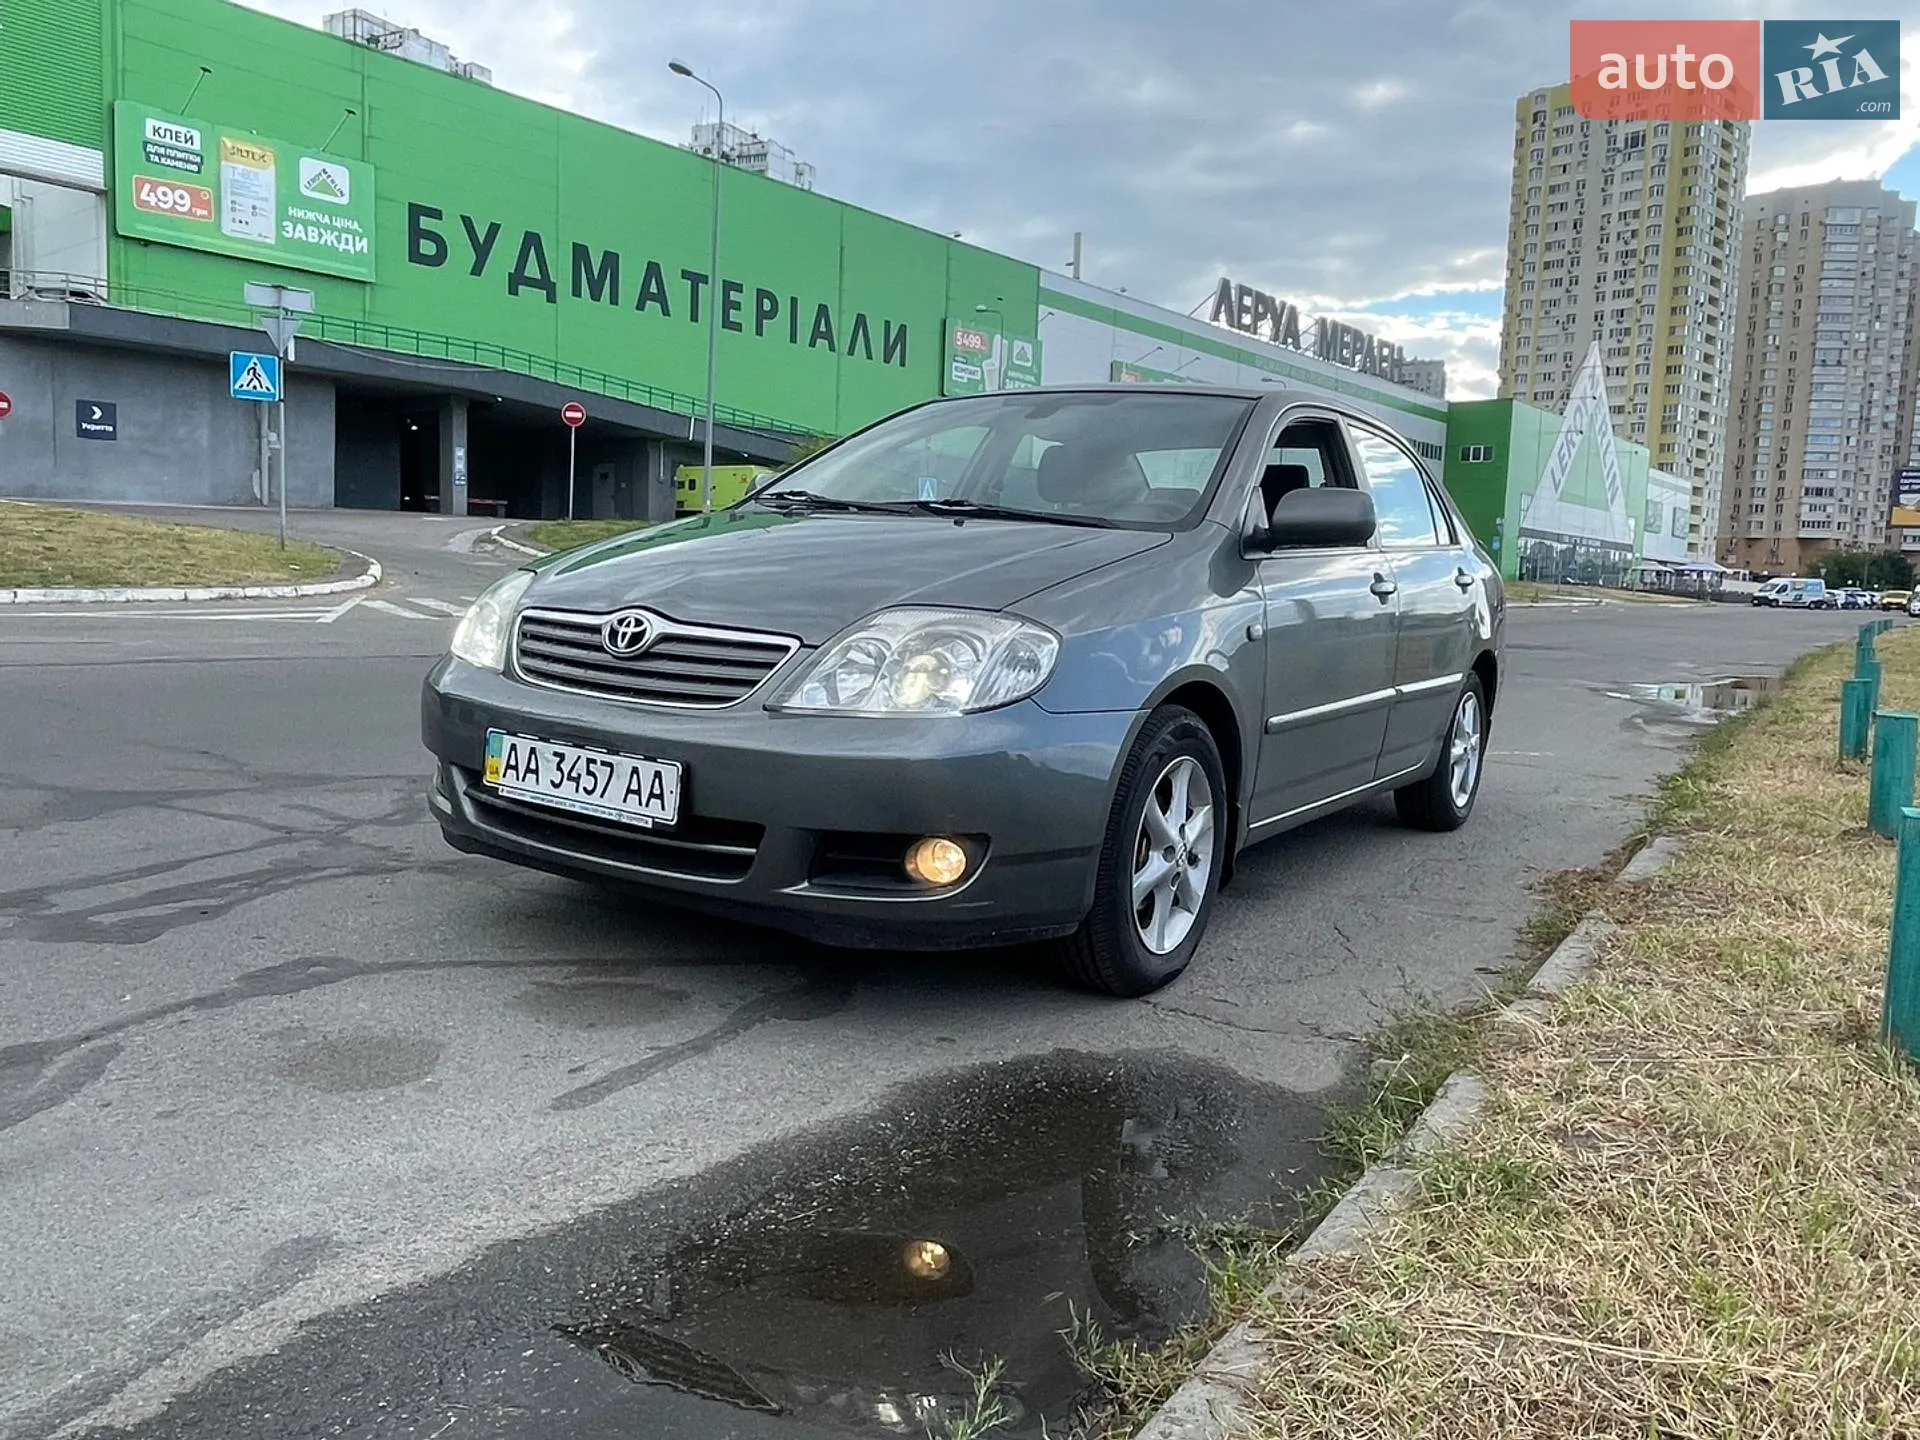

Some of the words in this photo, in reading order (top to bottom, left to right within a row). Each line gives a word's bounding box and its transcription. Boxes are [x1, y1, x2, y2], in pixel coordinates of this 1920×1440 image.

[146, 143, 166, 156] ДЛЯ
[151, 124, 194, 147] КЛЕЙ
[150, 154, 160, 164] ТА
[304, 171, 324, 190] LEROY
[322, 167, 346, 198] MERLIN
[140, 182, 191, 213] 499
[191, 206, 209, 217] грн
[287, 205, 331, 226] НИЖЧА
[331, 215, 363, 234] ЦІНА,
[281, 220, 369, 256] ЗАВЖДИ
[406, 200, 908, 369] БУДМАТЕРІАЛИ
[1210, 277, 1301, 350] ЛЕРУА
[956, 331, 981, 349] 5499
[502, 742, 540, 786] AA
[549, 750, 615, 799] 3457
[622, 766, 666, 812] AA
